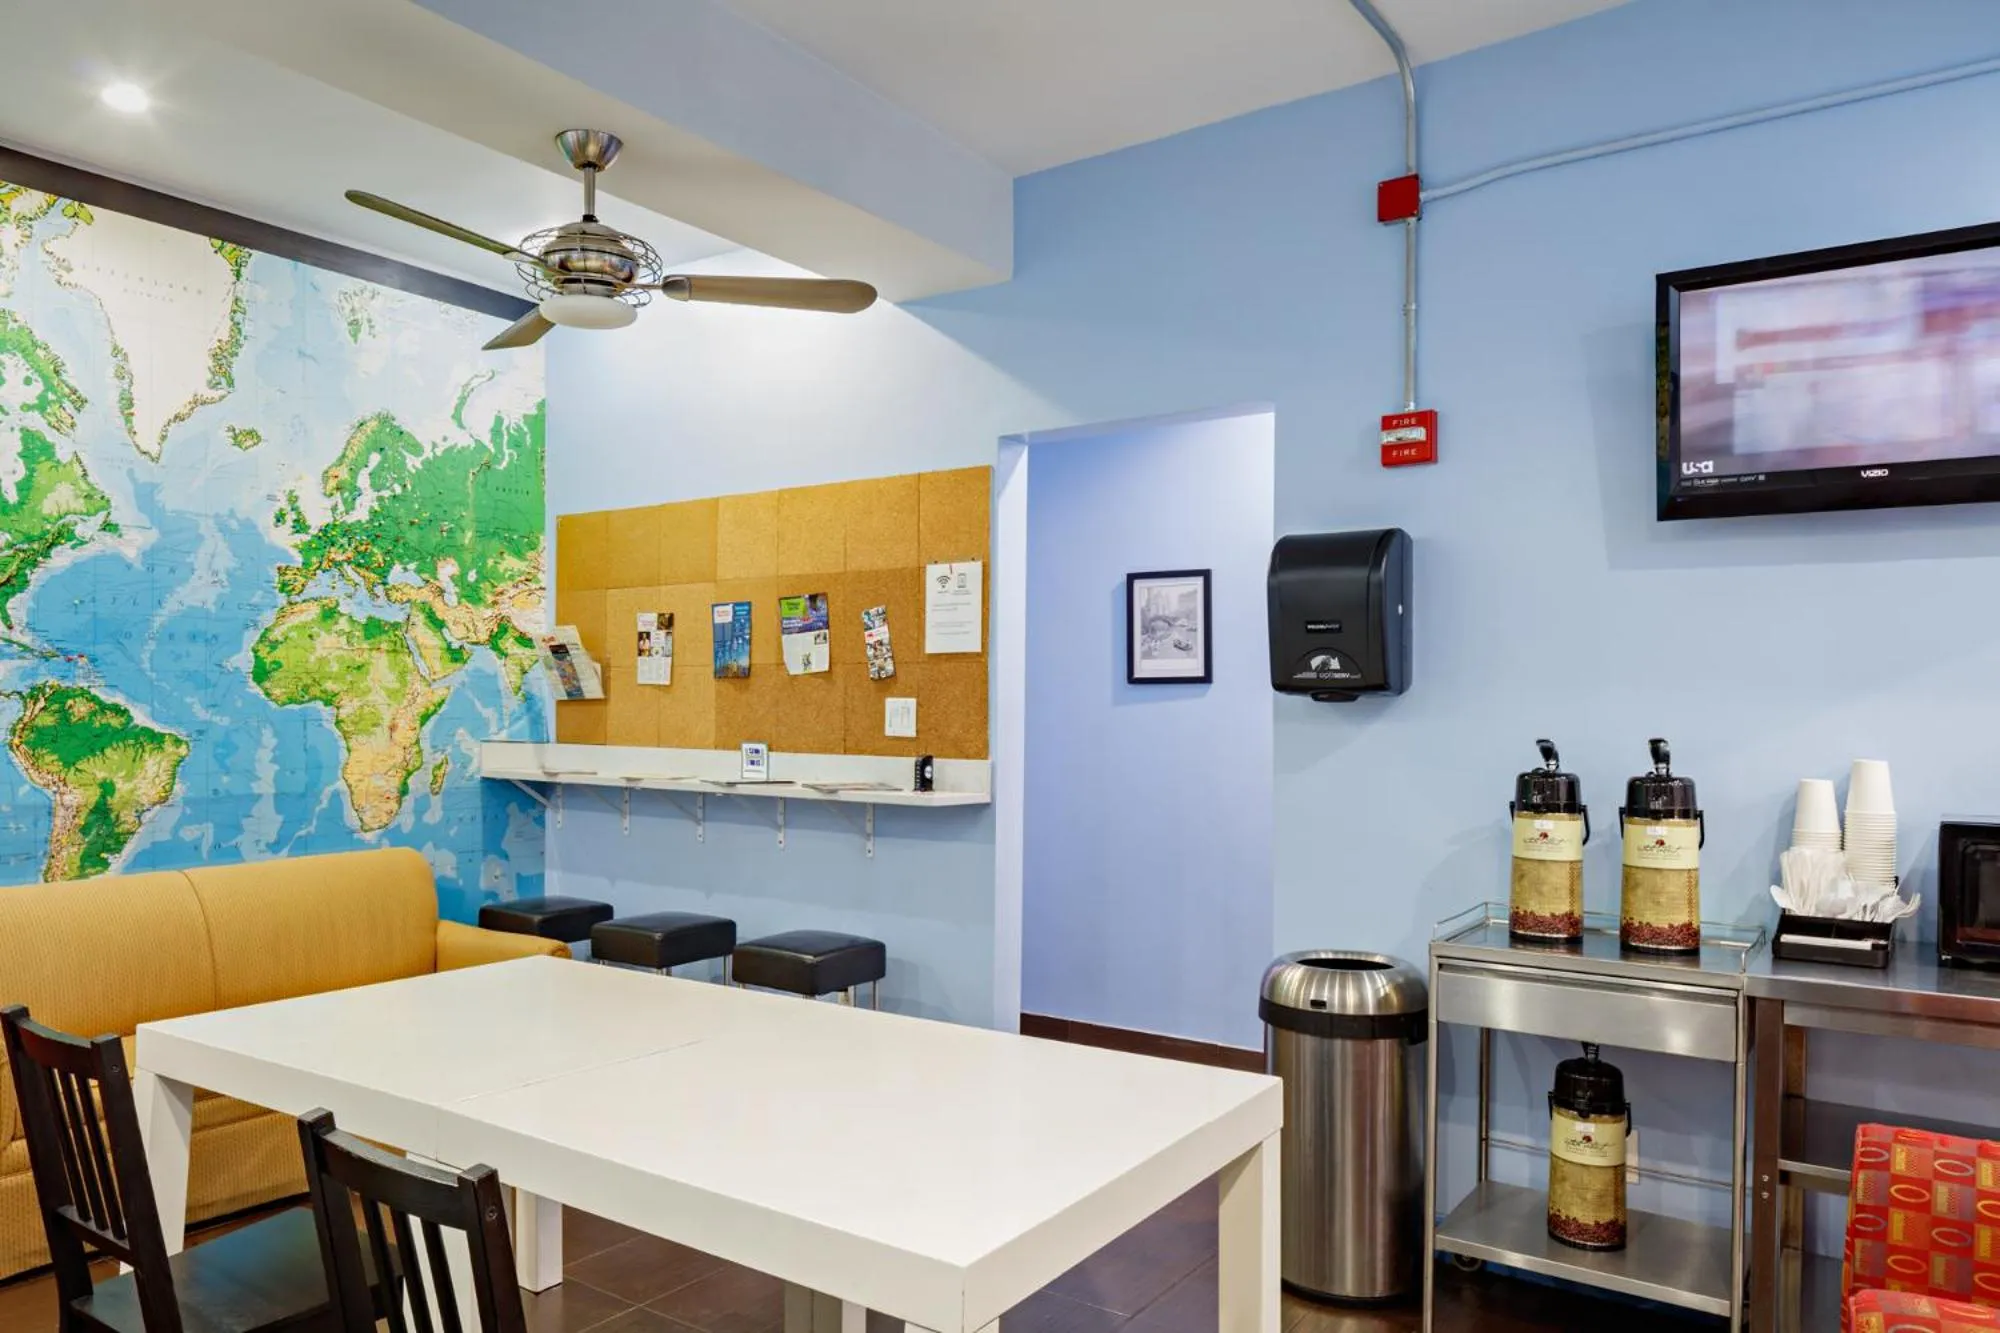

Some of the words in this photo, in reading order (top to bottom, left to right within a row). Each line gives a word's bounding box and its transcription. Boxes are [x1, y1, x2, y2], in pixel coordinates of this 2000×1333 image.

[1392, 418, 1417, 426] FIRE
[1392, 448, 1418, 457] FIRE
[1861, 468, 1889, 478] VIZIO
